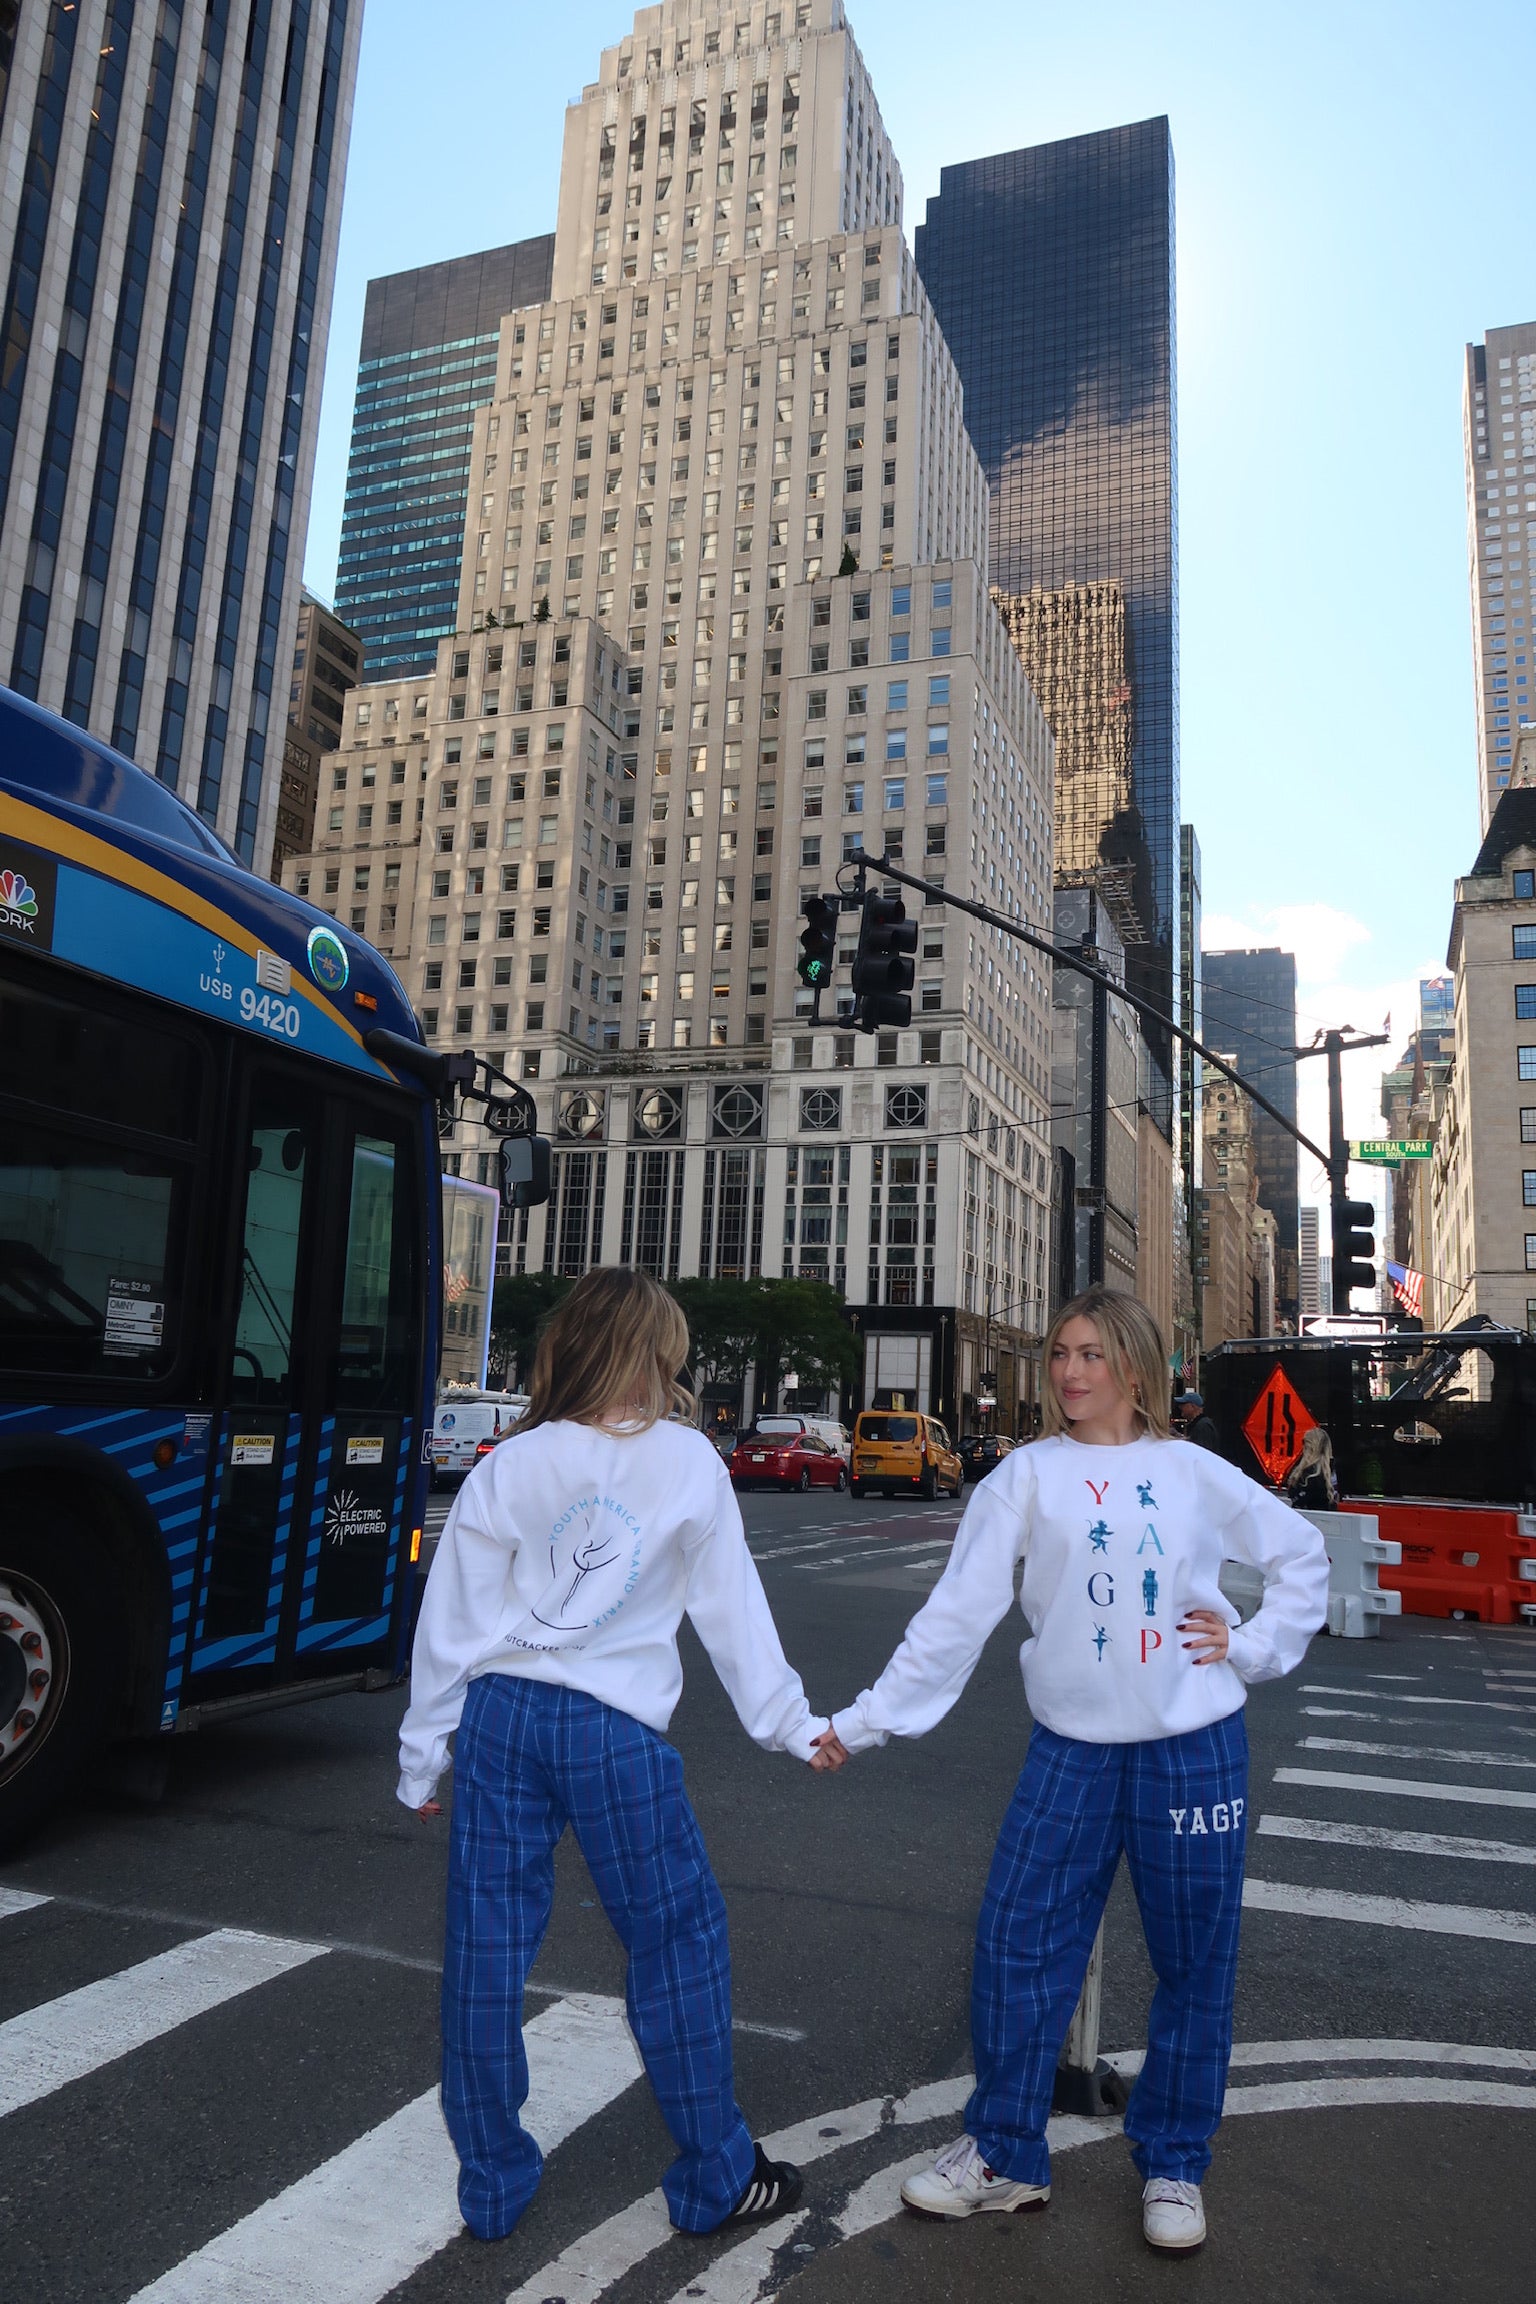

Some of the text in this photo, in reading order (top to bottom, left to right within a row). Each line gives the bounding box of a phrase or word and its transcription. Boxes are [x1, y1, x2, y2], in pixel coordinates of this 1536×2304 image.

[200, 973, 232, 1000] USB
[240, 987, 300, 1038] 9420
[1363, 1142, 1402, 1153] CENTRAL
[1405, 1142, 1428, 1153] PARK
[110, 1279, 130, 1290] Fare:
[109, 1300, 135, 1311] OMNY
[242, 1437, 272, 1446] CAUTION
[355, 1439, 382, 1447] CAUTION
[1085, 1480, 1110, 1505] Y
[340, 1509, 382, 1522] ELECTRIC
[343, 1522, 387, 1536] POWERED
[1136, 1523, 1165, 1556] A
[548, 1498, 589, 1542] YOUTH
[592, 1600, 624, 1628] PRIX
[1087, 1571, 1115, 1607] G
[1140, 1628, 1162, 1664] P
[1168, 1797, 1244, 1835] YAGP
